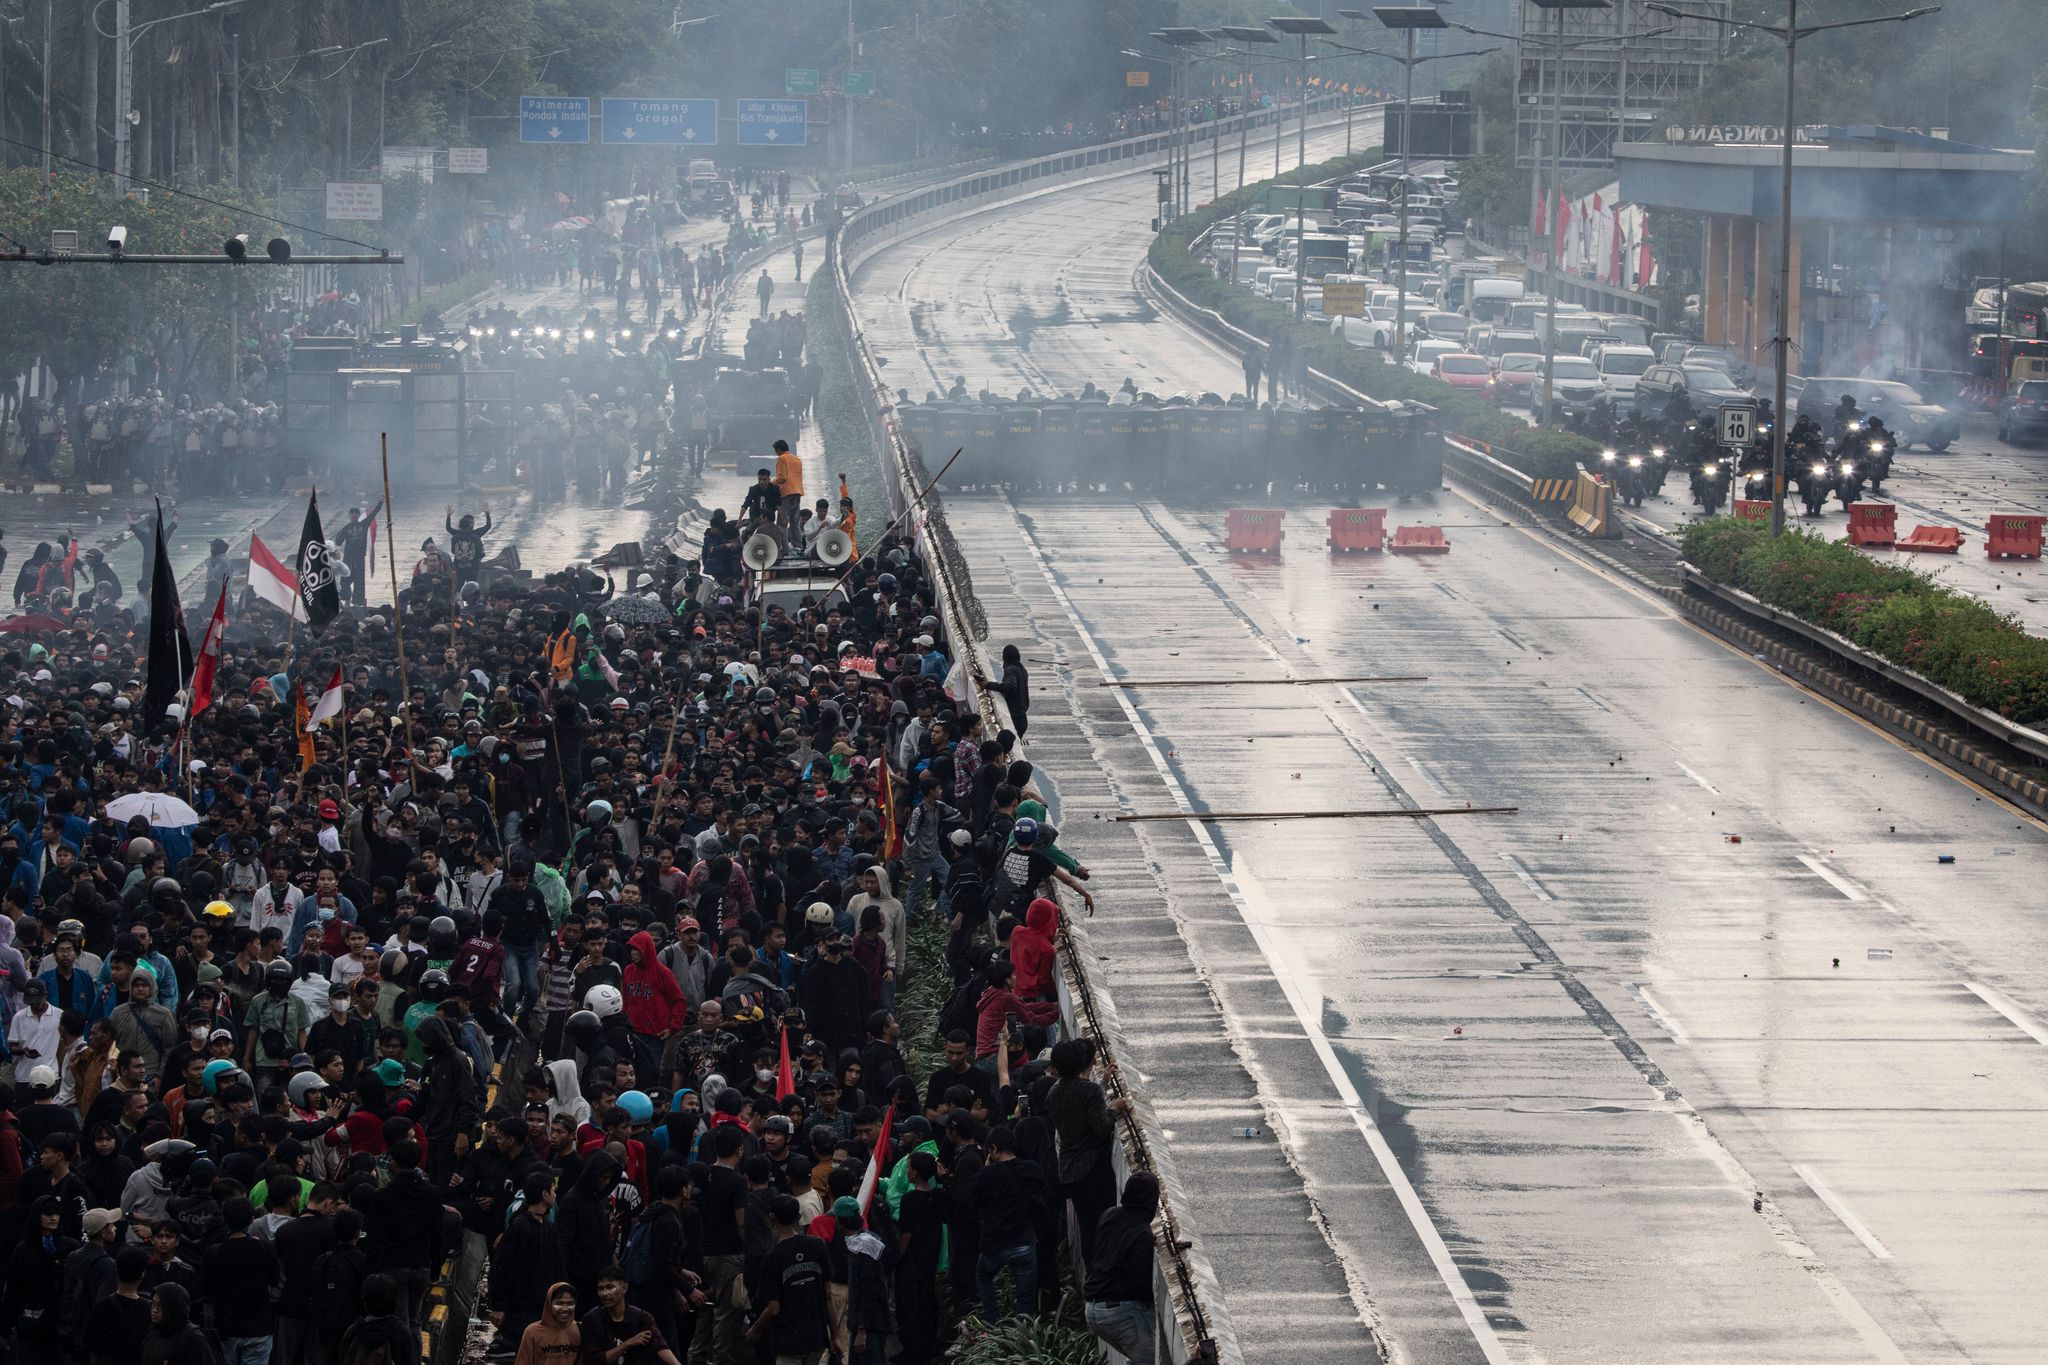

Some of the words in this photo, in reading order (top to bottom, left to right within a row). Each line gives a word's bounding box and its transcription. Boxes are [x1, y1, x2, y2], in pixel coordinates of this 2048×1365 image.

[529, 101, 581, 110] Palmerah
[631, 102, 689, 114] Tomang
[747, 103, 765, 112] Jalur
[522, 111, 557, 121] Pondok
[561, 112, 587, 121] Indah
[635, 115, 684, 124] Grogol
[740, 112, 754, 122] Bus
[1728, 424, 1745, 438] 10
[466, 954, 479, 972] 2
